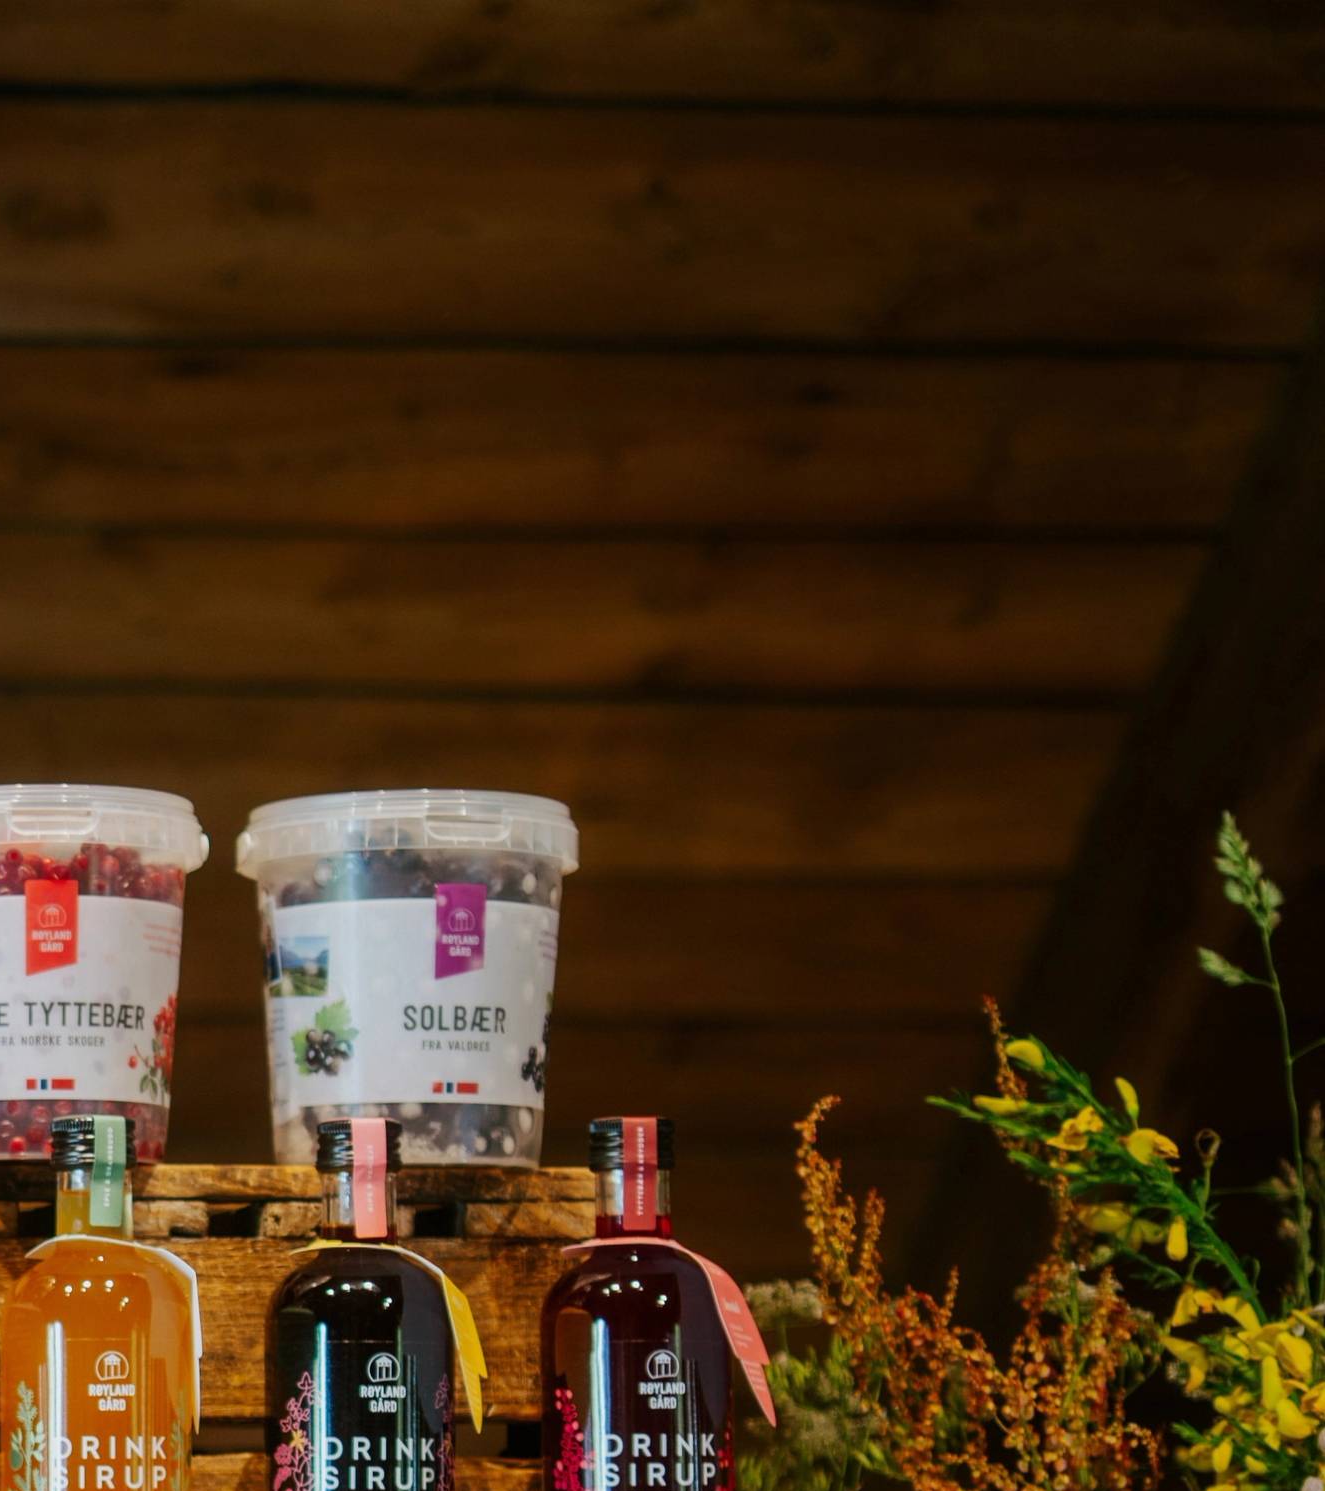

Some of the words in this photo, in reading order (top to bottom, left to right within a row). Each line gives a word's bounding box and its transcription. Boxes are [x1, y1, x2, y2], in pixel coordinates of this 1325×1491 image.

[24, 1002, 145, 1031] TYTTEBÆR
[403, 1005, 507, 1034] SOLBÆR
[22, 1036, 62, 1046] NORSKE
[423, 1041, 441, 1050] FRA
[639, 1382, 686, 1395] RØYLAND
[650, 1395, 676, 1409] GÅRD
[51, 1435, 167, 1460] DRINK
[325, 1437, 435, 1462] DRINK
[604, 1433, 716, 1458] DRINK
[53, 1465, 167, 1490] SIRUP
[325, 1467, 435, 1491] SIRUP
[605, 1463, 716, 1487] SIRUP
